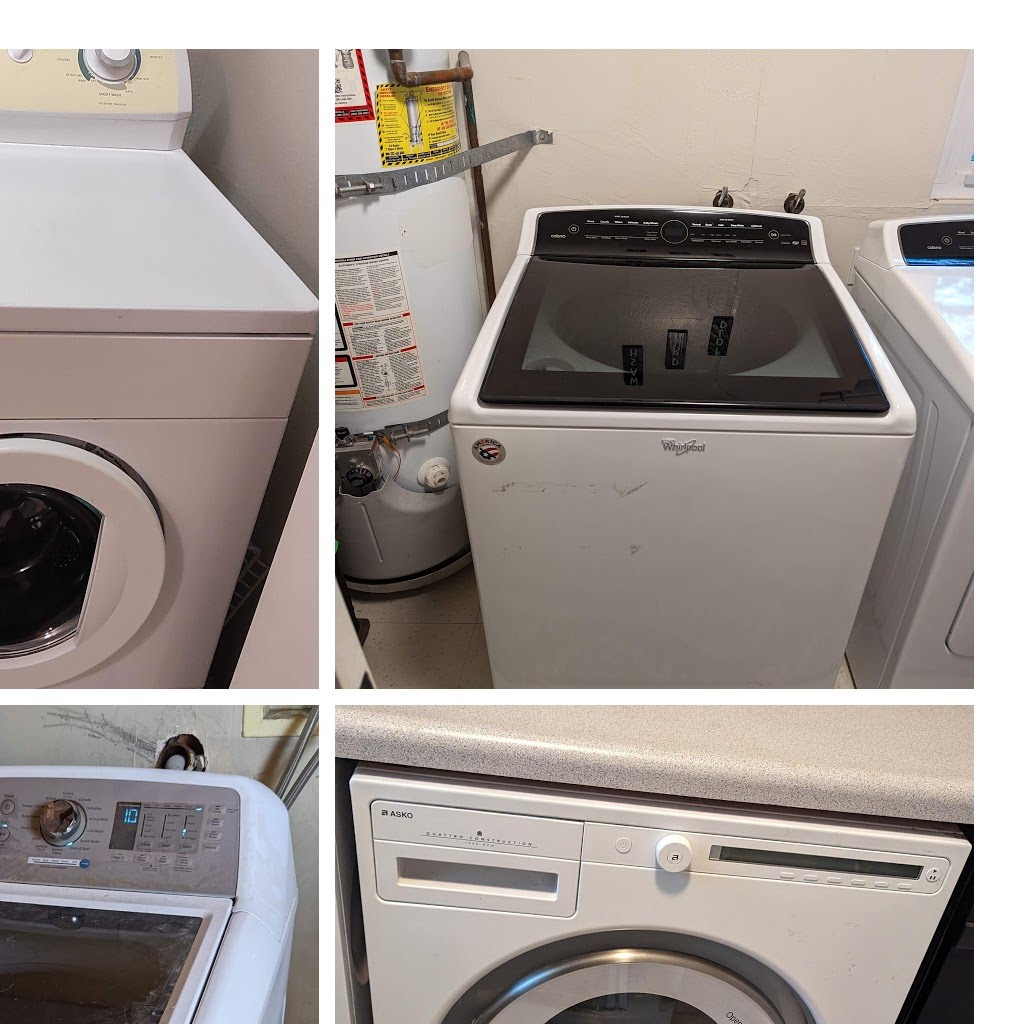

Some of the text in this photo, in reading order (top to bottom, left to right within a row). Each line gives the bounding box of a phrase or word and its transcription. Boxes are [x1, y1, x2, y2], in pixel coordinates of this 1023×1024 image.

[473, 439, 501, 451] AMERICA
[661, 438, 706, 456] Whirlpool
[123, 808, 138, 824] 10
[390, 810, 413, 819] ASKO
[426, 831, 533, 847] QUATTRO CONSTRUCTION
